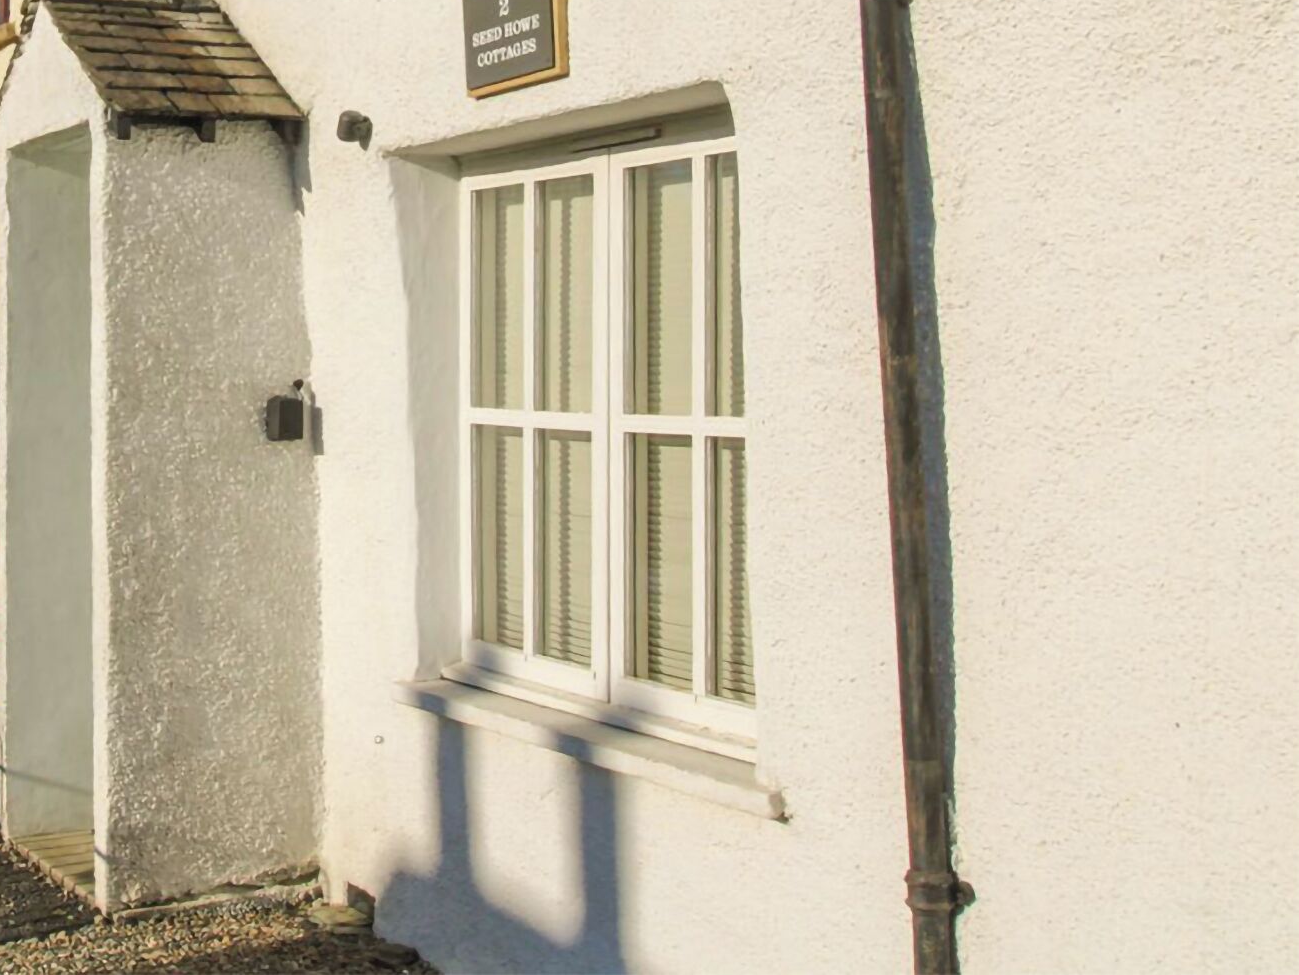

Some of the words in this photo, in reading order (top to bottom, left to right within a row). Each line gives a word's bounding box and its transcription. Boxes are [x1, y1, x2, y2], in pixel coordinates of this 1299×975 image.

[472, 26, 502, 47] SEED
[504, 14, 540, 37] HOWE
[477, 38, 537, 67] COTTAGES
